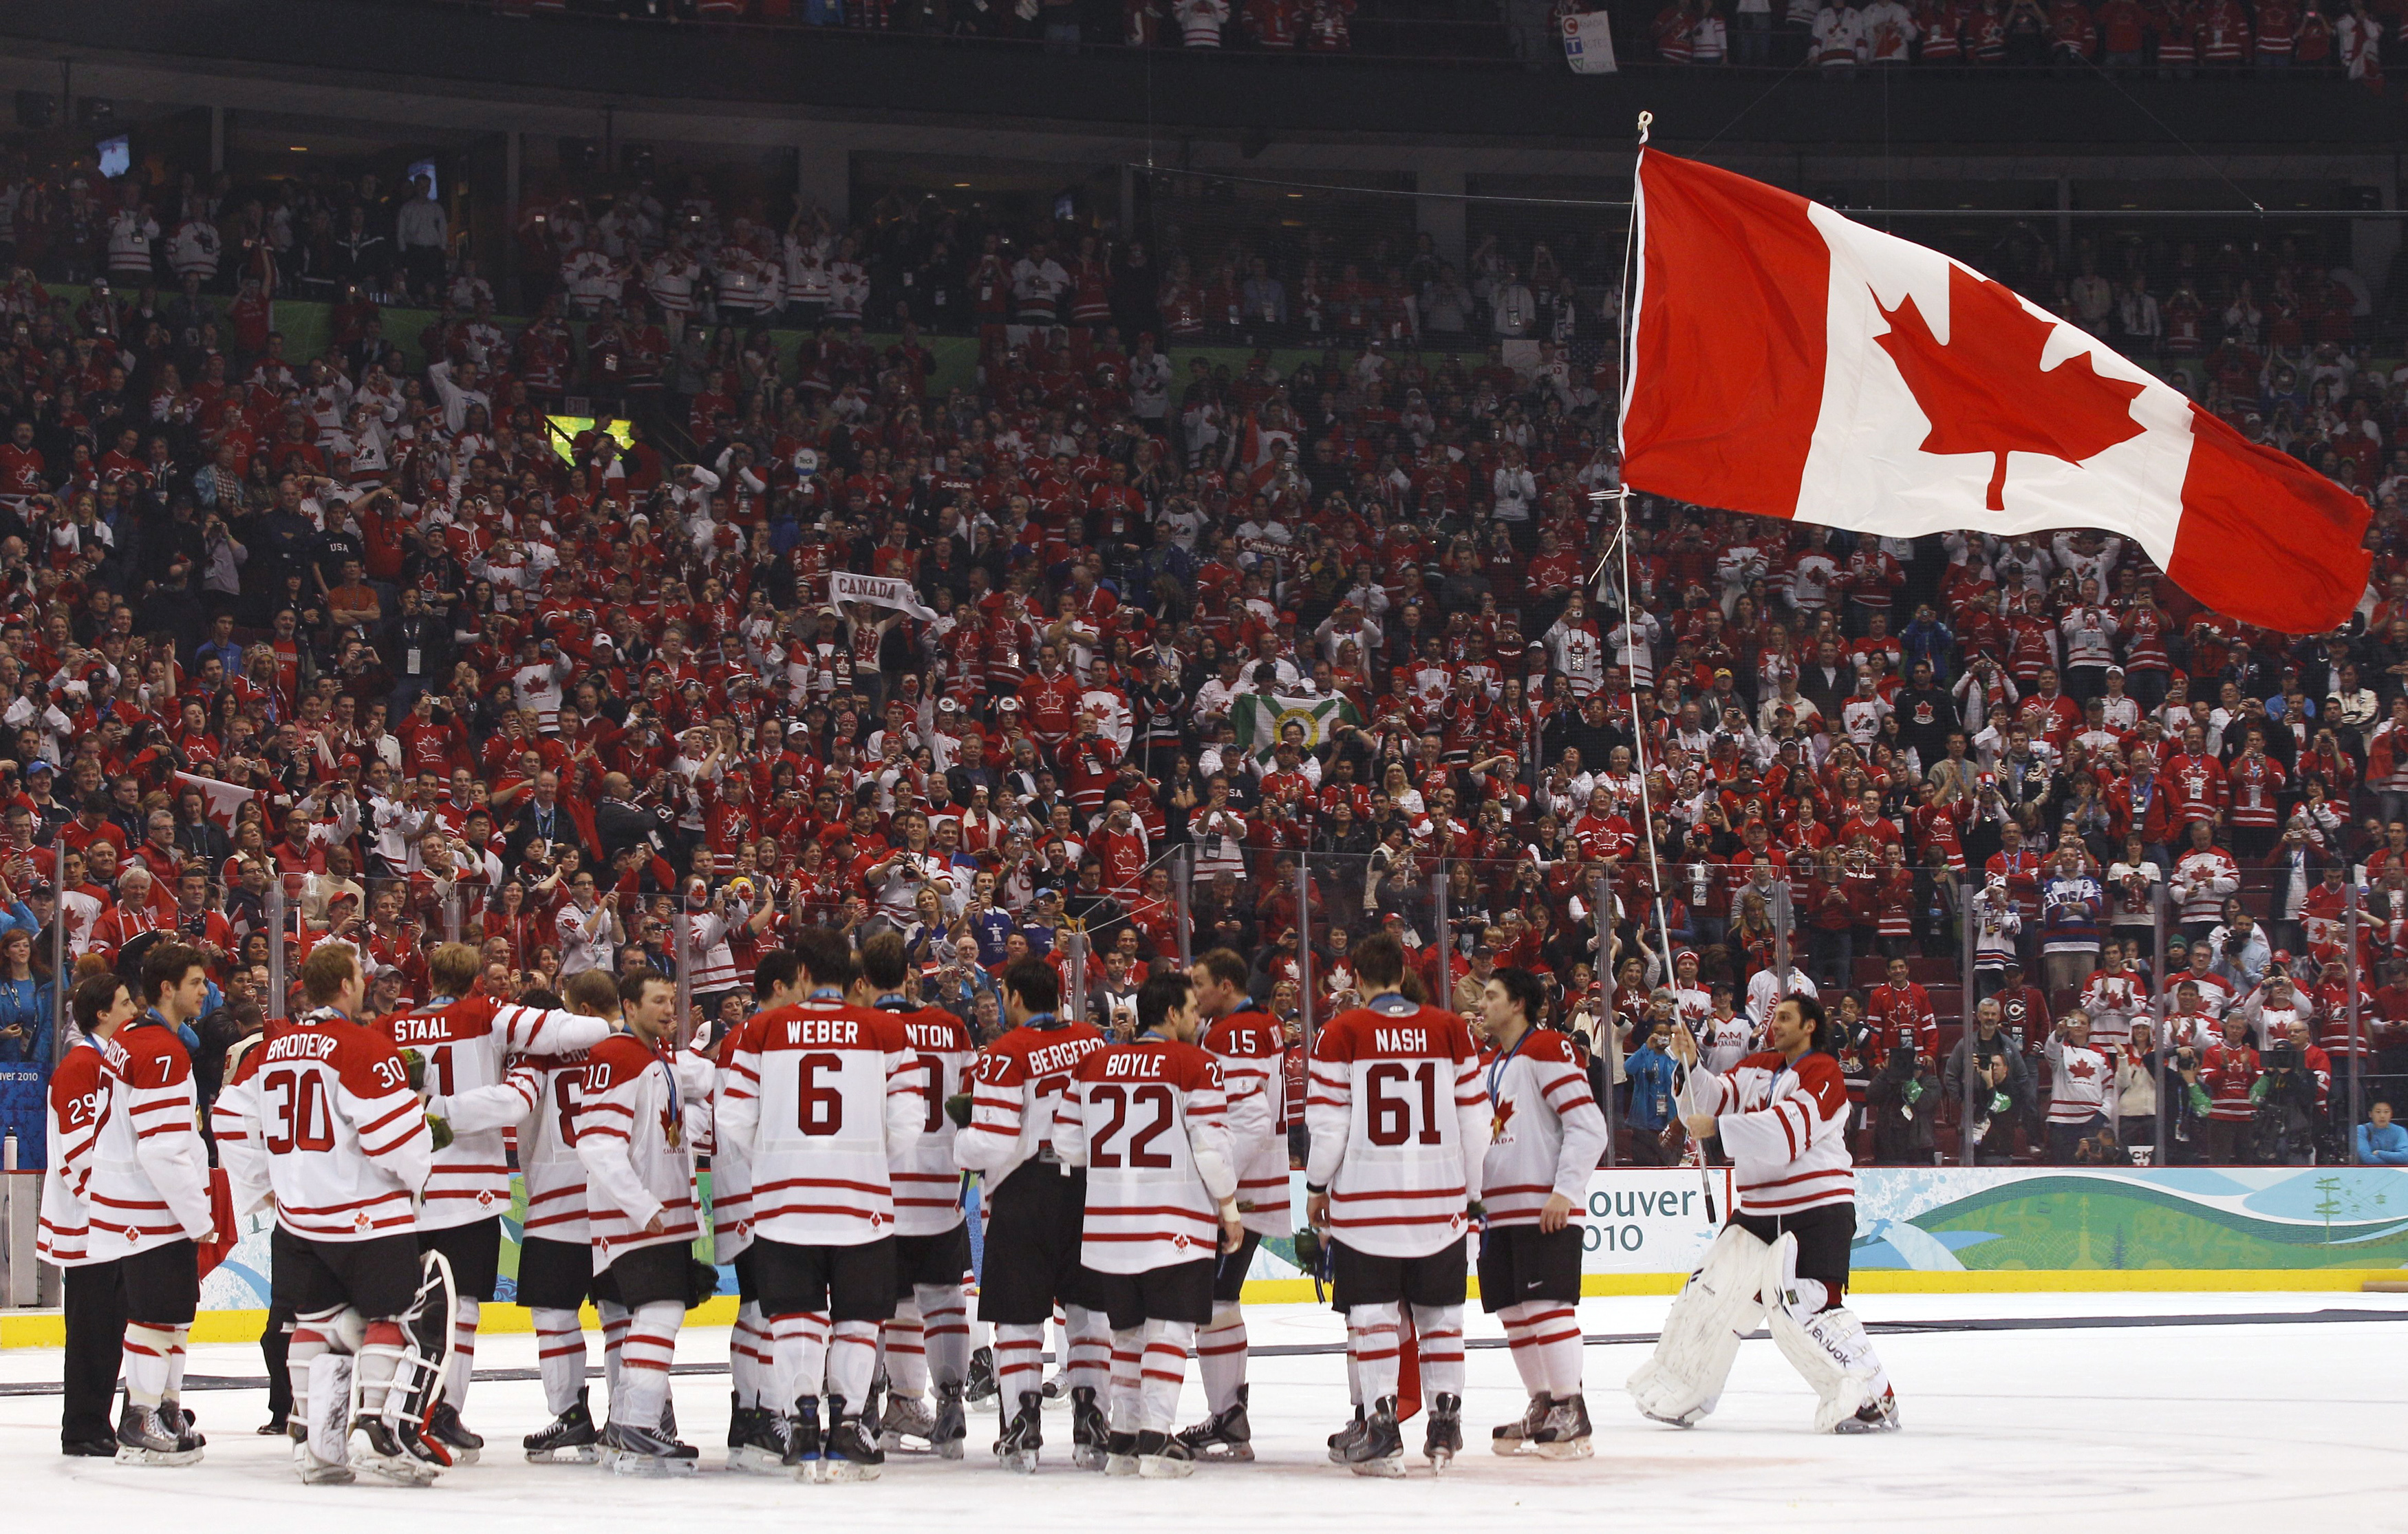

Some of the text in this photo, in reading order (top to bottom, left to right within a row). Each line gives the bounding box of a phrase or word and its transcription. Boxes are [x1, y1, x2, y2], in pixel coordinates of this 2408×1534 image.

[799, 456, 814, 465] Teck
[330, 543, 350, 553] USA
[838, 578, 896, 600] CANADA
[1229, 789, 1244, 798] SA
[394, 1017, 453, 1043] STAAL
[786, 1021, 859, 1045] WEBER
[1229, 1028, 1257, 1054] 15
[1375, 1028, 1427, 1053] NASH
[1717, 1032, 1742, 1040] AM
[18, 1072, 39, 1082] 2010
[155, 1054, 172, 1082] 7
[372, 1055, 407, 1089] 30
[585, 1063, 612, 1091] 10
[979, 1054, 1013, 1082] 37
[1104, 1054, 1165, 1077] BOYLE
[797, 1053, 843, 1136] 6
[1366, 1062, 1441, 1147] 61
[264, 1069, 336, 1155] 30
[1089, 1084, 1172, 1169] 22
[1589, 1188, 1697, 1217] ouver
